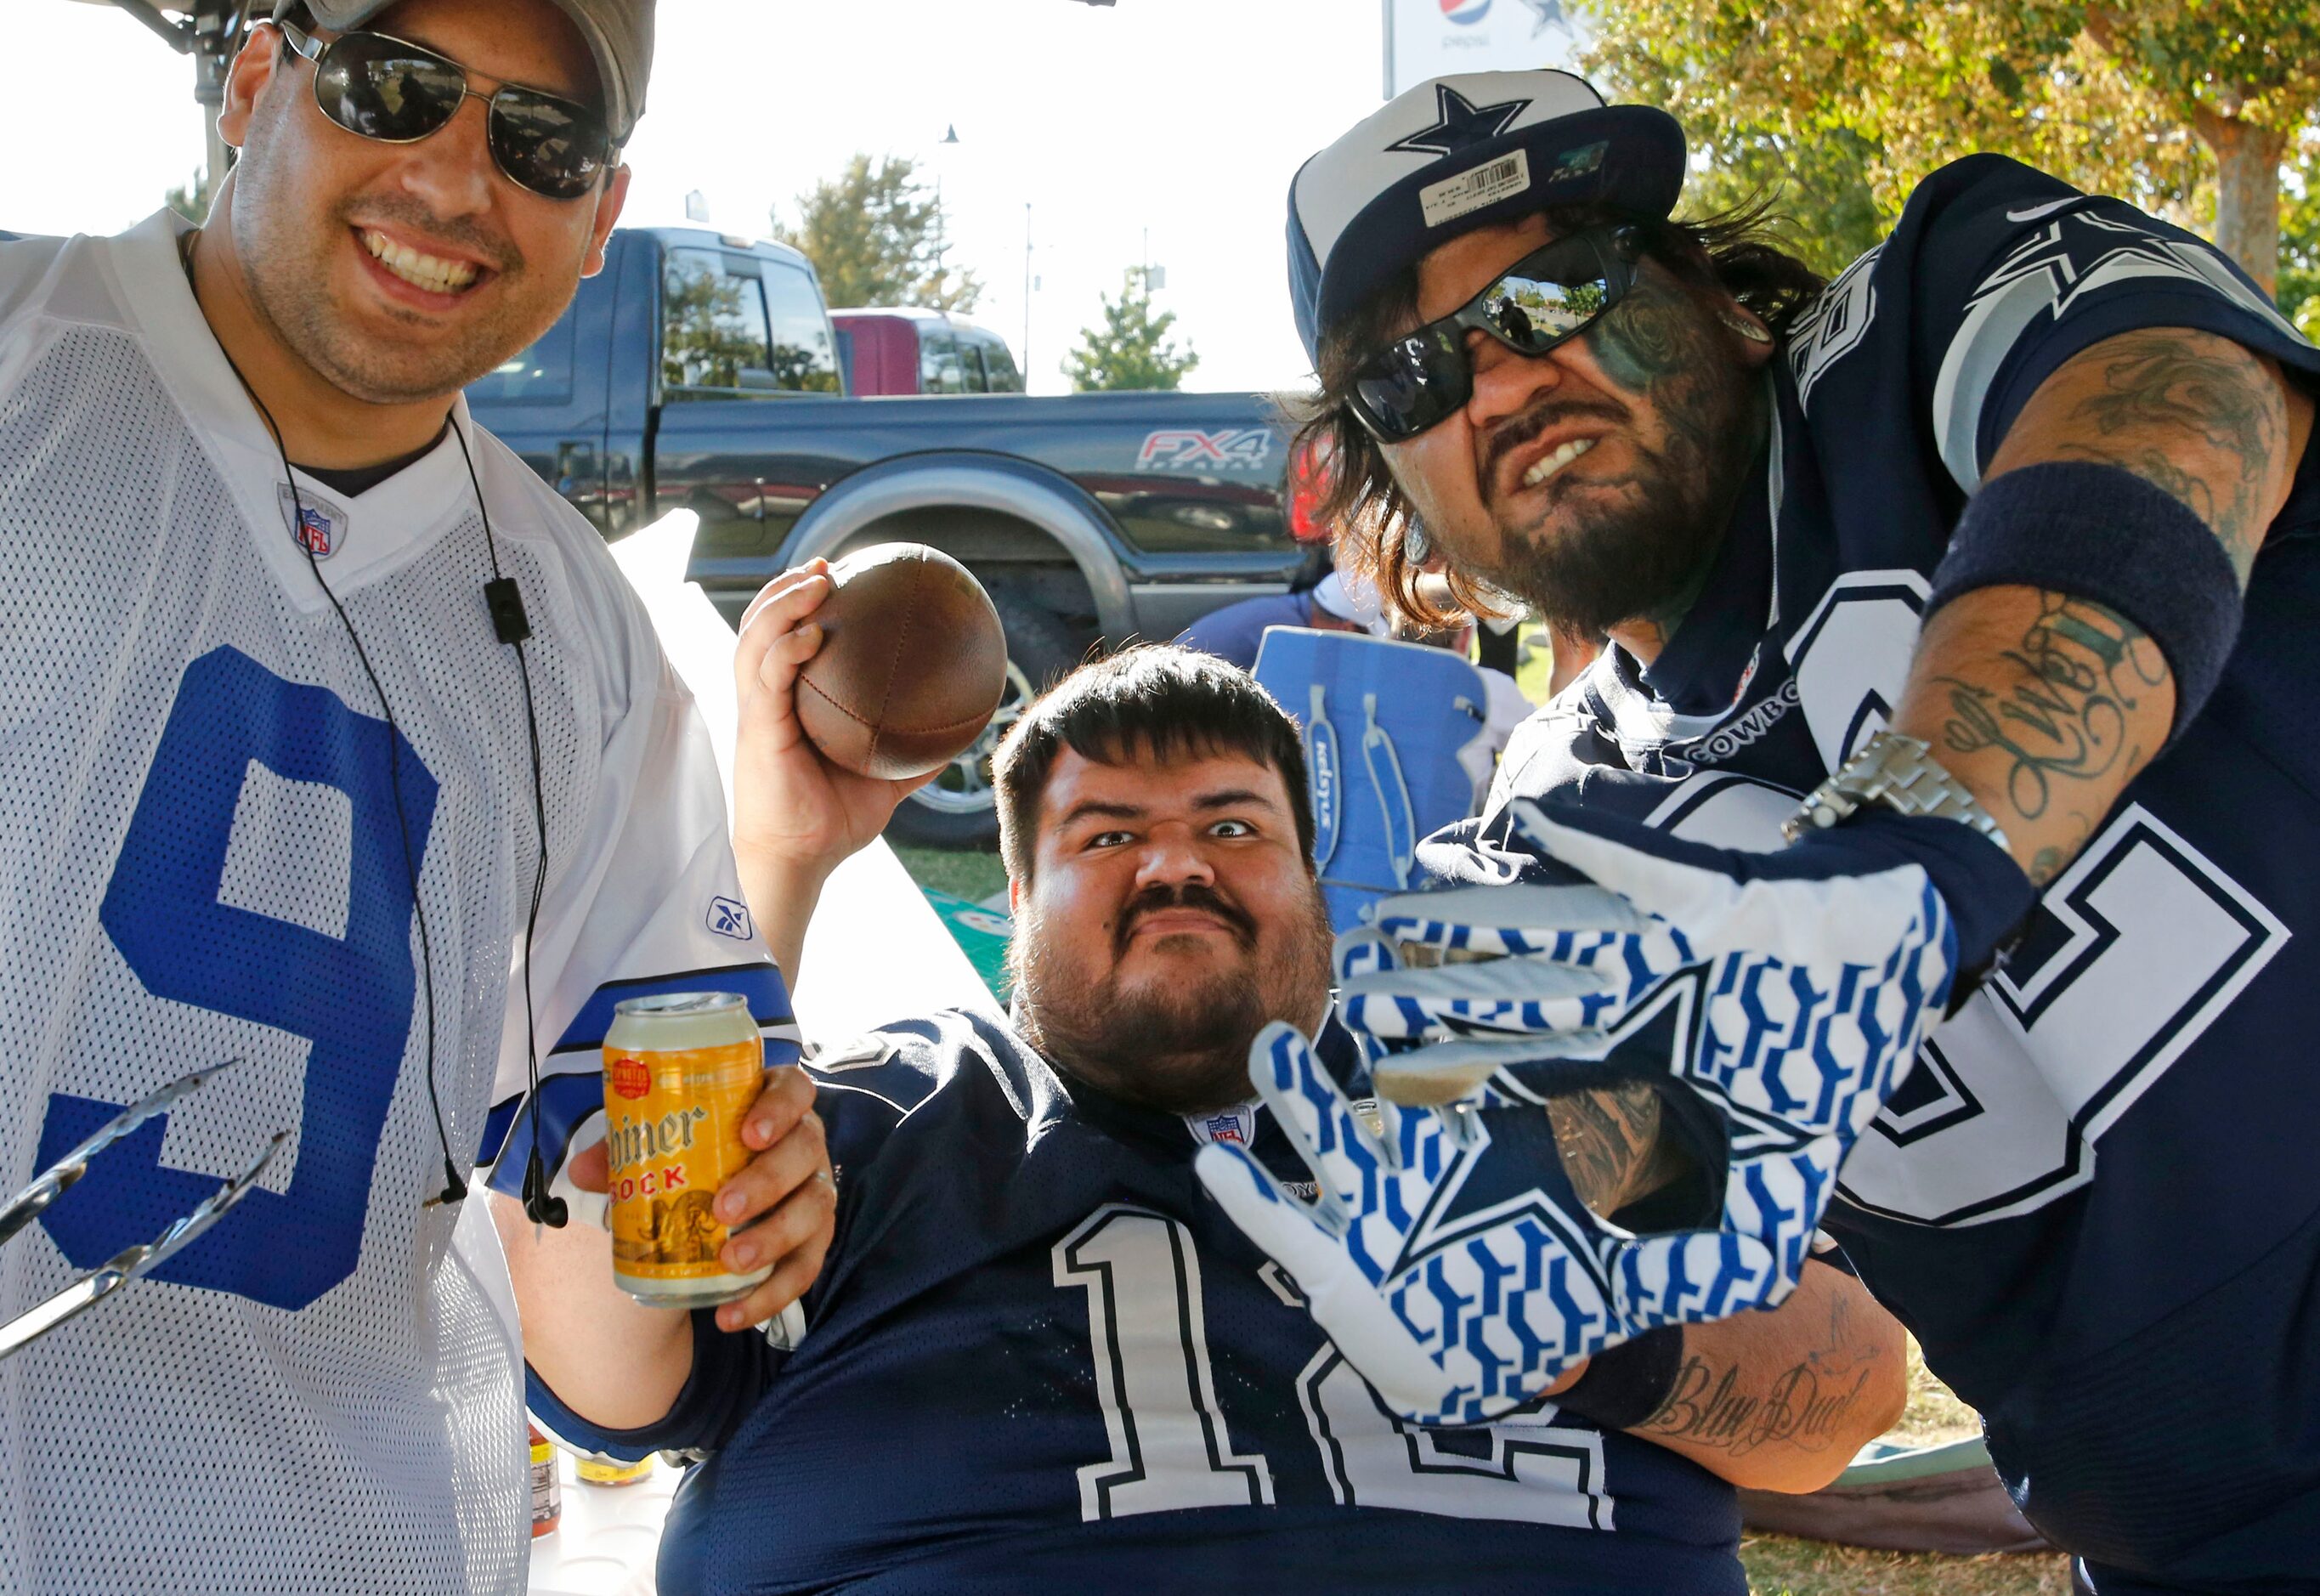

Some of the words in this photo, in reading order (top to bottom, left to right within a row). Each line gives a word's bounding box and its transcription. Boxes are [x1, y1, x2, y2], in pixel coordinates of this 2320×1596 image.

[1137, 428, 1270, 462] FX4
[297, 524, 329, 554] NFL
[1683, 677, 1801, 764] COWBO
[32, 643, 440, 1311] 9
[608, 1106, 705, 1174] hiner
